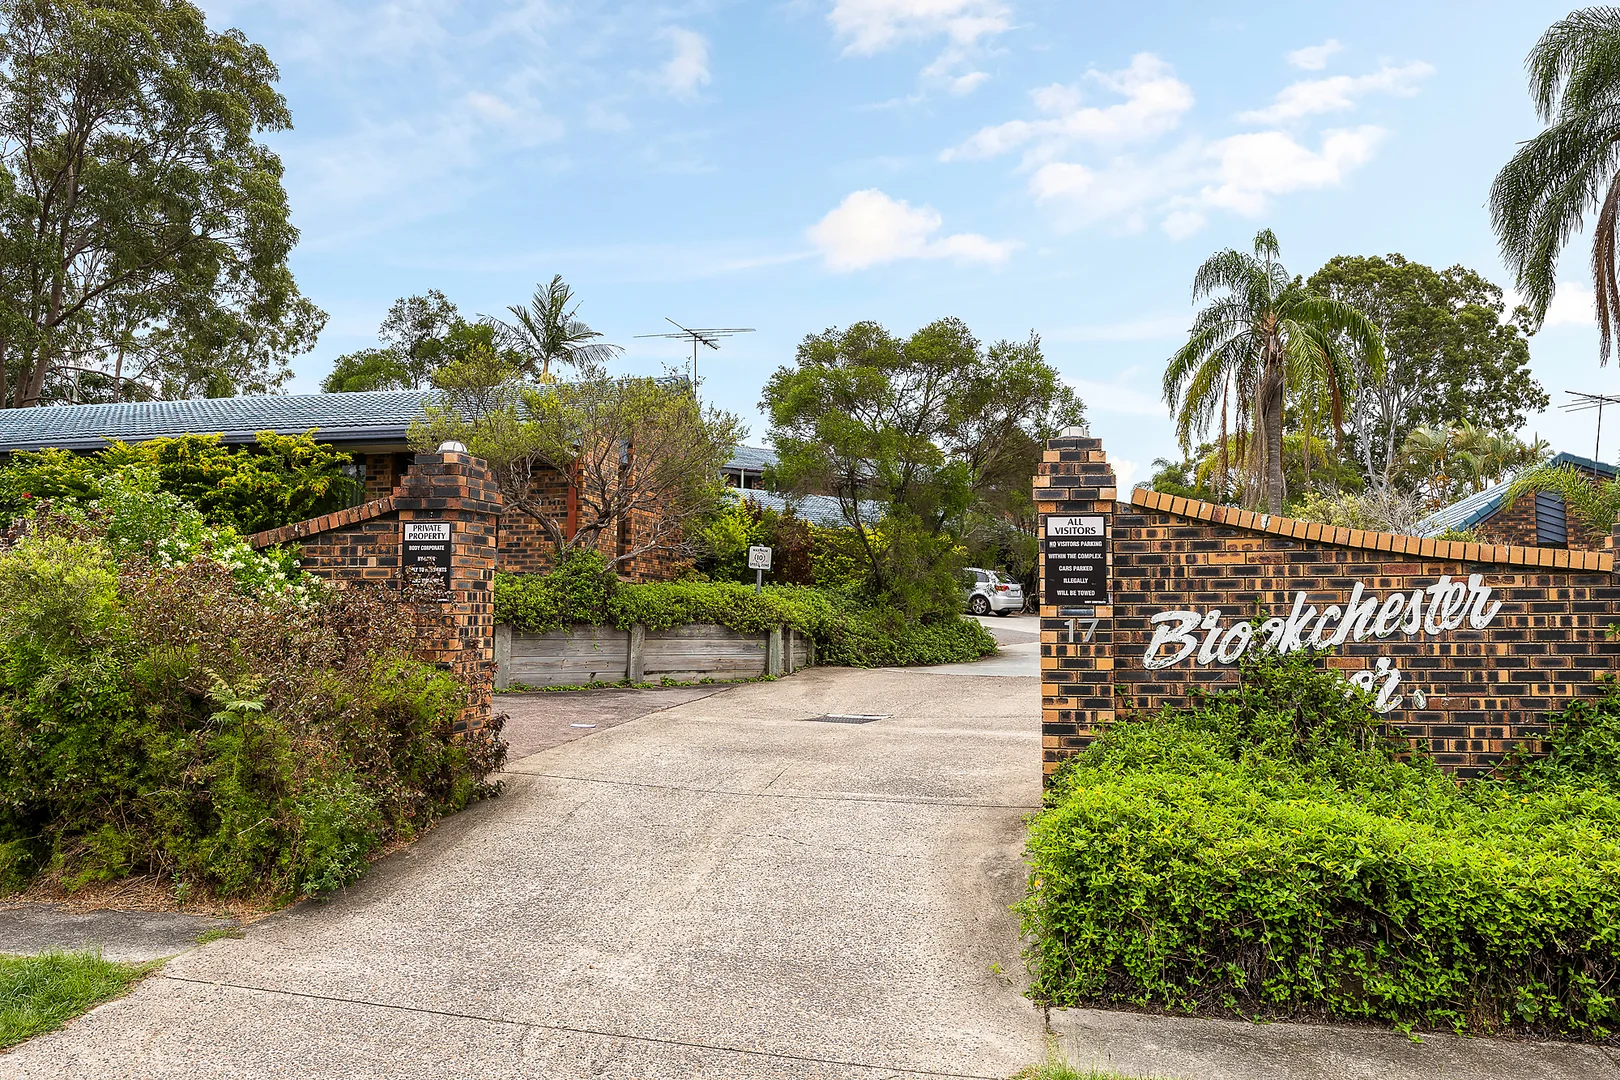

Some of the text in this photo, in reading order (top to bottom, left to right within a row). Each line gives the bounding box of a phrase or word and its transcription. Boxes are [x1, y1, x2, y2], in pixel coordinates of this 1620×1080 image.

[1067, 518, 1083, 526] ALL
[412, 524, 442, 532] PRIVATE
[1054, 526, 1096, 535] VISITORS
[408, 532, 446, 540] PROPERTY
[1142, 573, 1503, 670] Brookchester
[1063, 618, 1100, 643] 17
